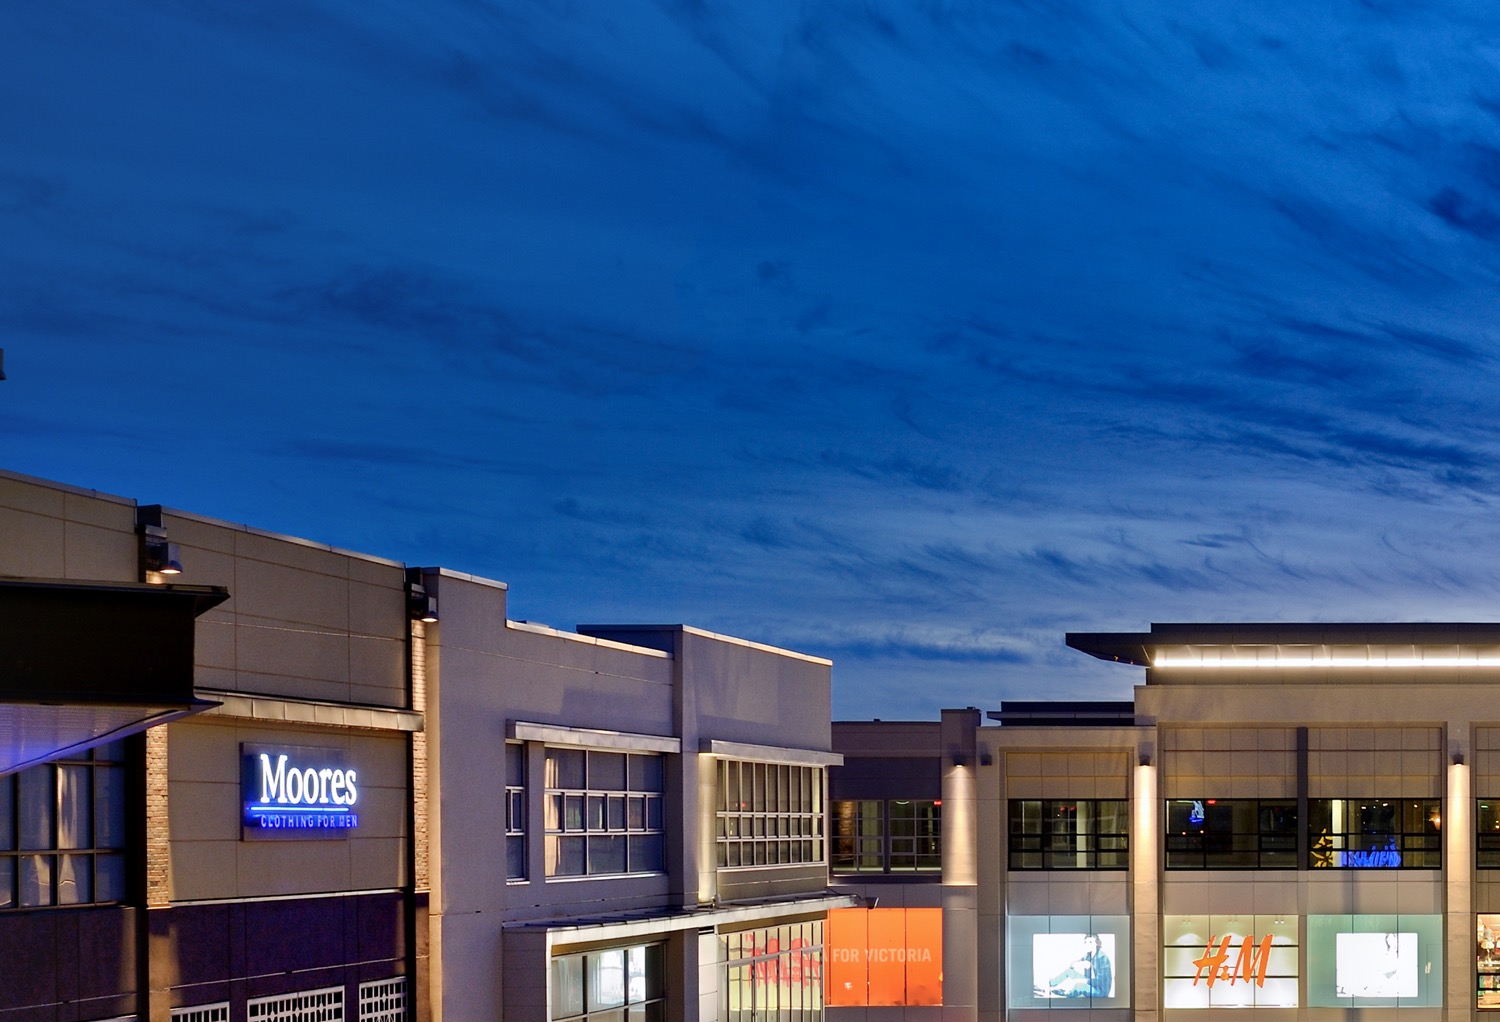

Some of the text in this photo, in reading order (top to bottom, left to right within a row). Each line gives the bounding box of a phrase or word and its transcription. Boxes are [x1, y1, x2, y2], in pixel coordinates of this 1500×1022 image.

[260, 753, 357, 805] Moores
[260, 815, 358, 828] CLOTHING FOR MEN
[833, 948, 859, 962] FOR
[865, 948, 932, 962] VICTORIA
[1192, 934, 1274, 989] H&M
